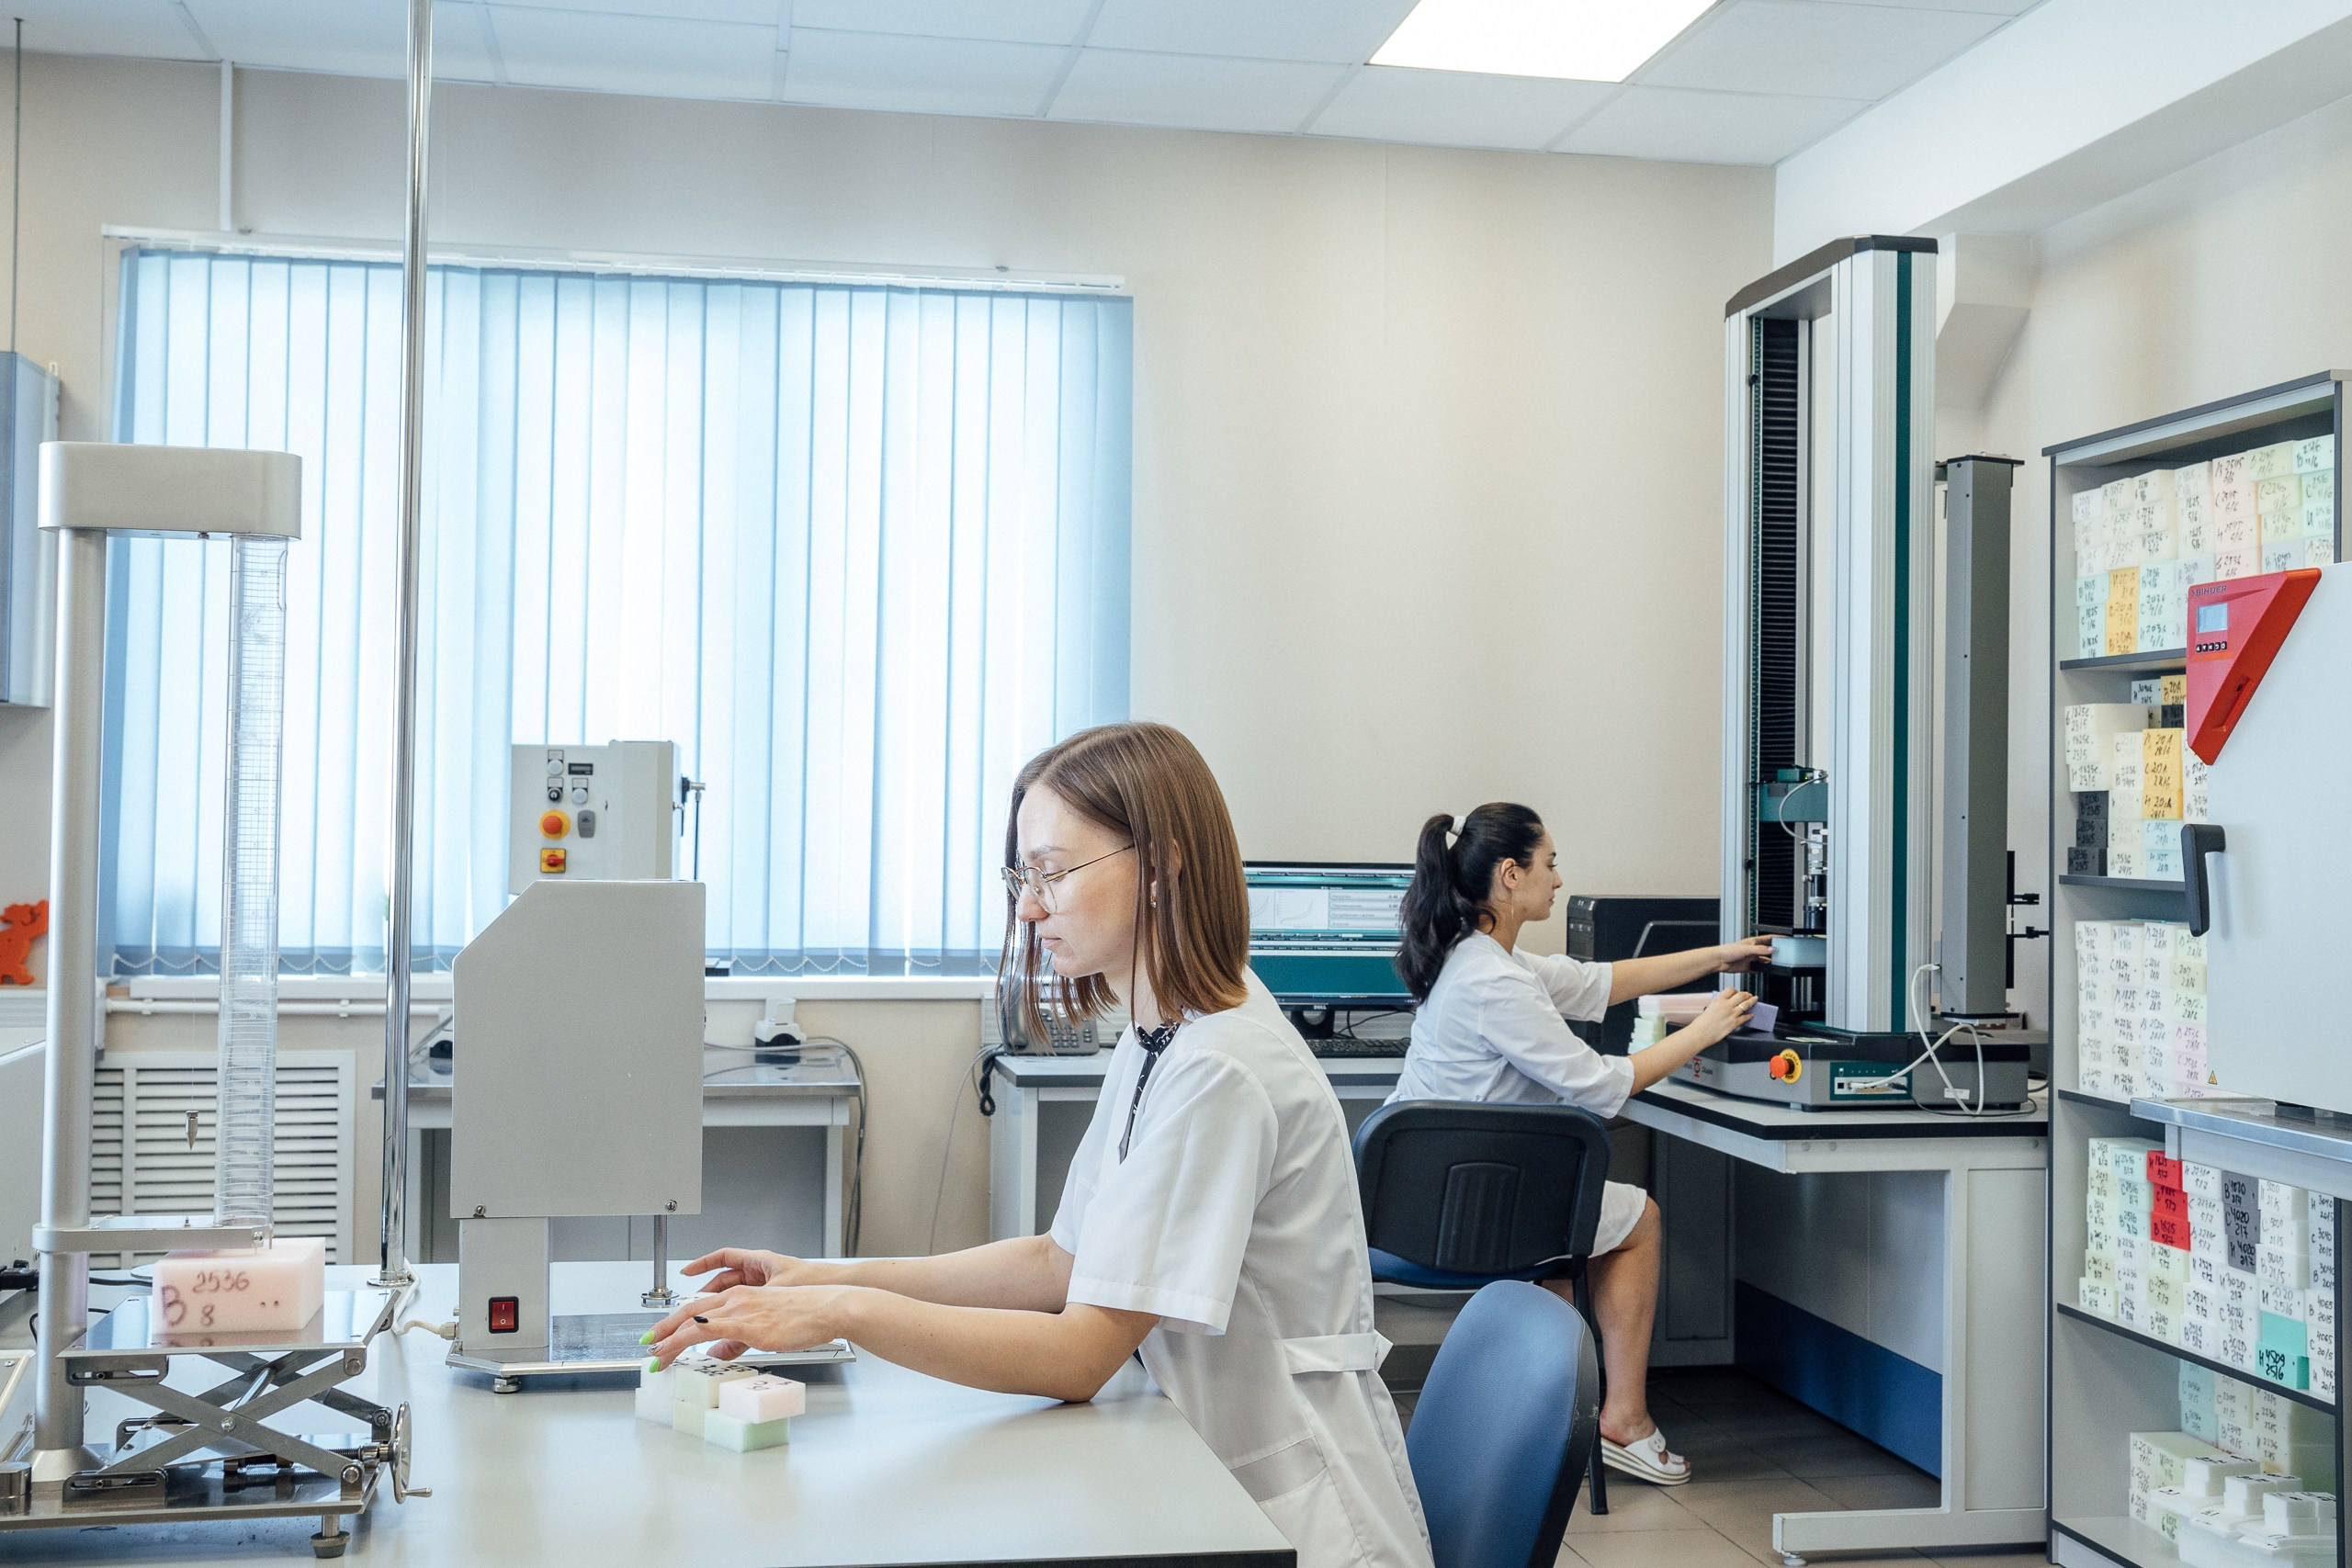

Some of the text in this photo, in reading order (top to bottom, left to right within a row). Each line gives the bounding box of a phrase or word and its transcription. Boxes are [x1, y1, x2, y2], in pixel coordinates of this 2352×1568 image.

[2196, 585, 2227, 597] BINDER
[2225, 1206, 2250, 1227] C 4020
[2311, 1233, 2316, 1244] C
[191, 1269, 250, 1293] 2536
[2261, 1289, 2268, 1305] H
[2309, 1294, 2334, 1316] B 4065
[200, 1303, 215, 1326] 8
[2273, 1299, 2293, 1316] 25/6
[2309, 1329, 2333, 1350] C 4065
[2258, 1349, 2265, 1367] H
[2317, 1346, 2334, 1361] 20/5
